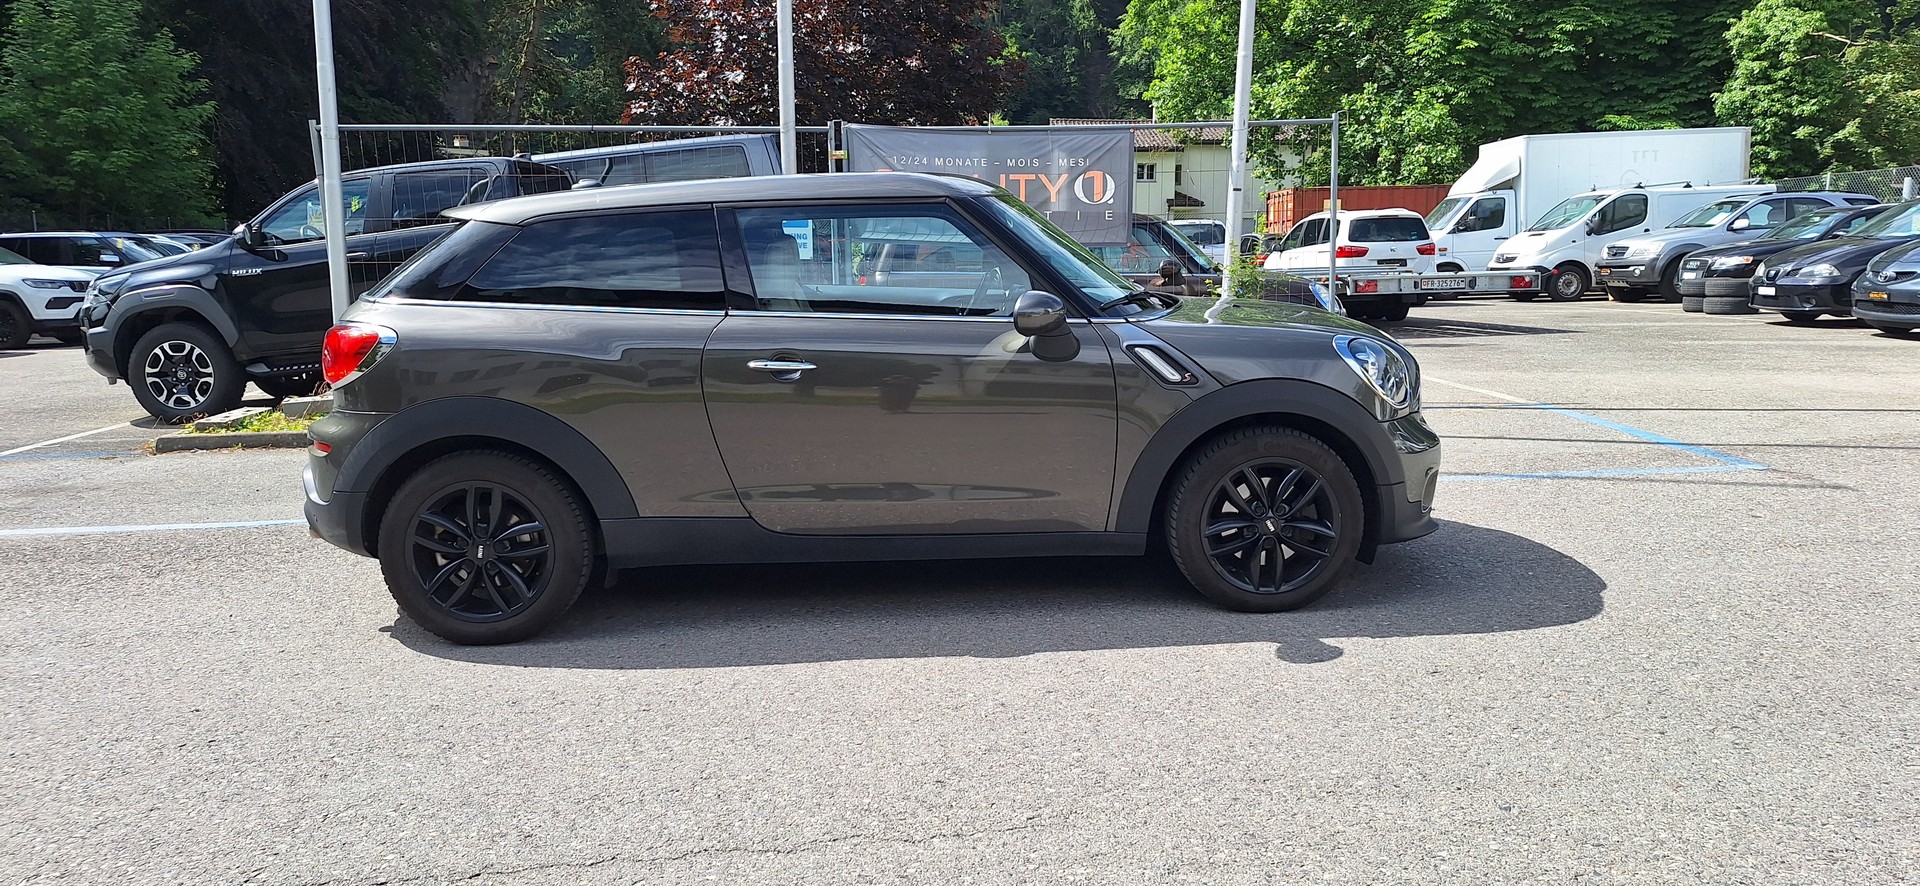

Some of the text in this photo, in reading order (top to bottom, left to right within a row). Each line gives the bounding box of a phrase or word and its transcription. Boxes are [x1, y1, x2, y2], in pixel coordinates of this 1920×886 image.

[892, 156, 928, 165] 12/24
[935, 157, 988, 167] MONATE
[1007, 158, 1040, 167] MOIS
[1059, 158, 1090, 167] MESI
